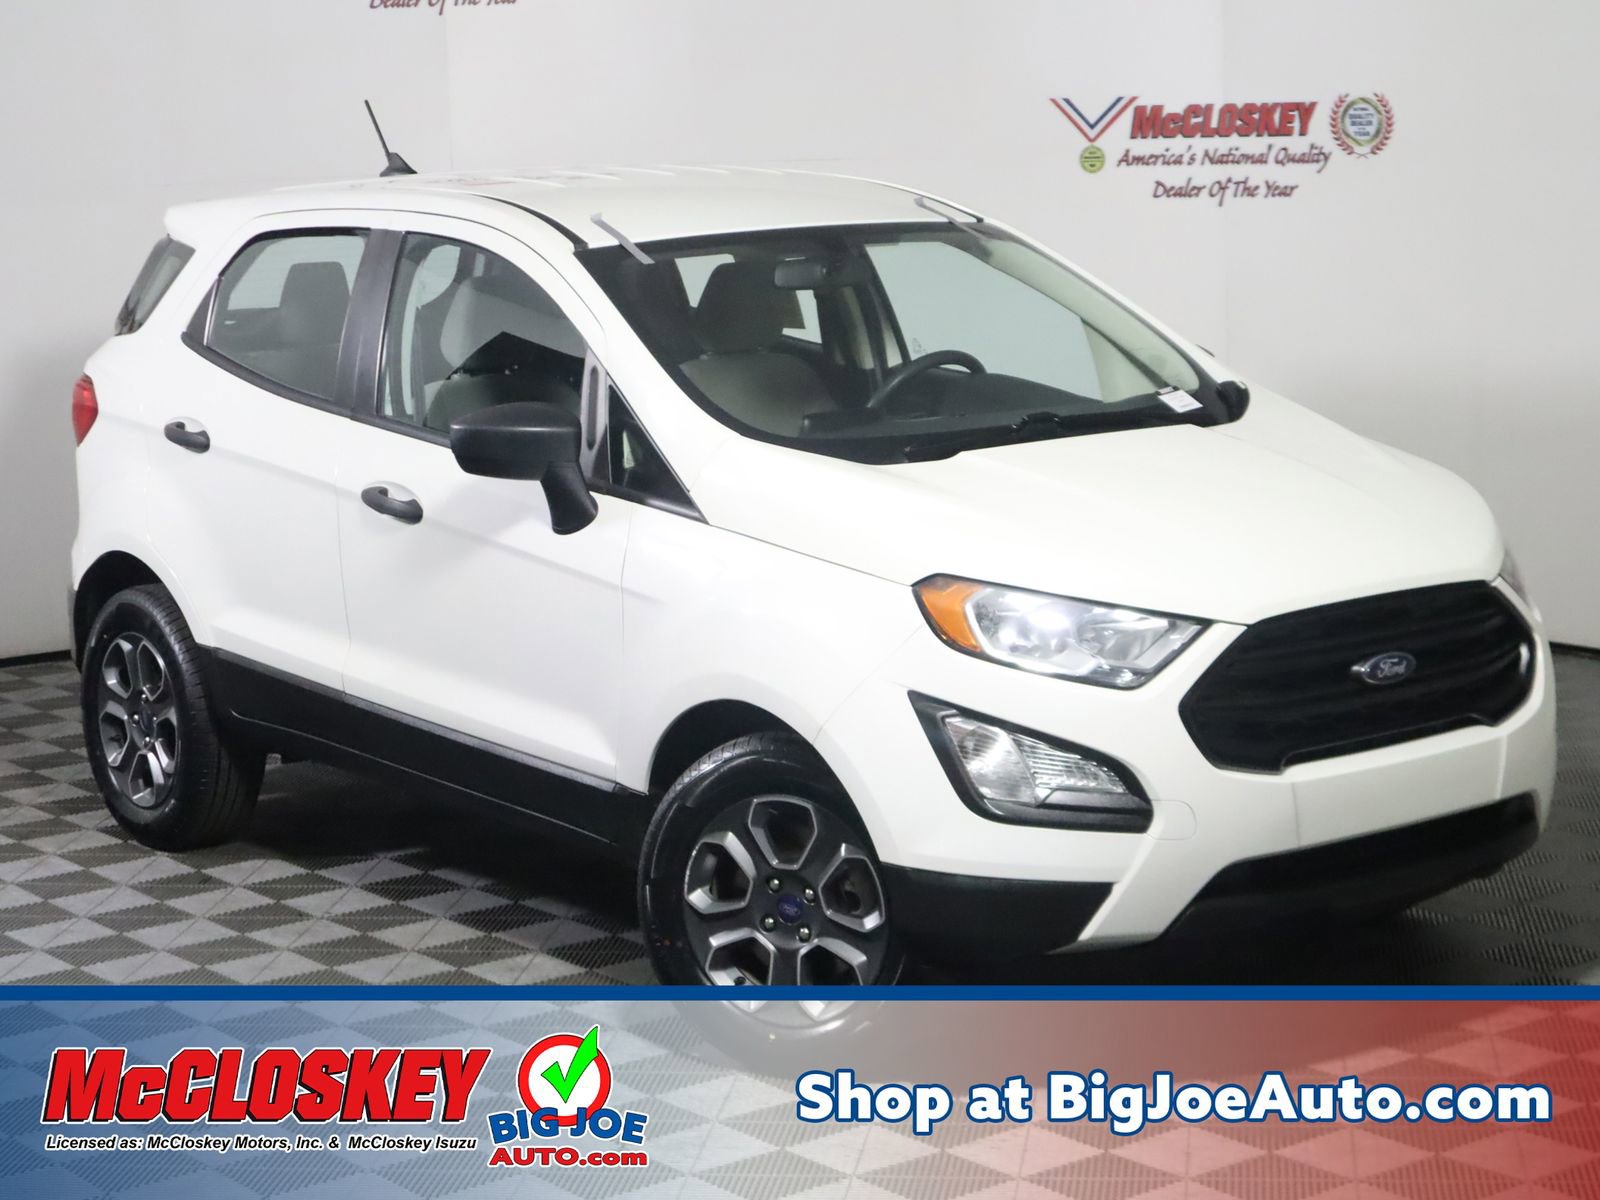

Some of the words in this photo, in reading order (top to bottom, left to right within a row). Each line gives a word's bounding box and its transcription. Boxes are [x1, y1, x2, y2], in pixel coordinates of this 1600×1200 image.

[1130, 101, 1318, 139] McCLOSKEY
[1117, 145, 1196, 166] America's
[1201, 143, 1272, 165] National
[1274, 143, 1332, 173] Quality
[1152, 177, 1206, 198] Dealer
[1208, 176, 1232, 207] Of
[1233, 176, 1260, 198] The
[1263, 180, 1299, 198] Year
[1377, 658, 1407, 678] Ford
